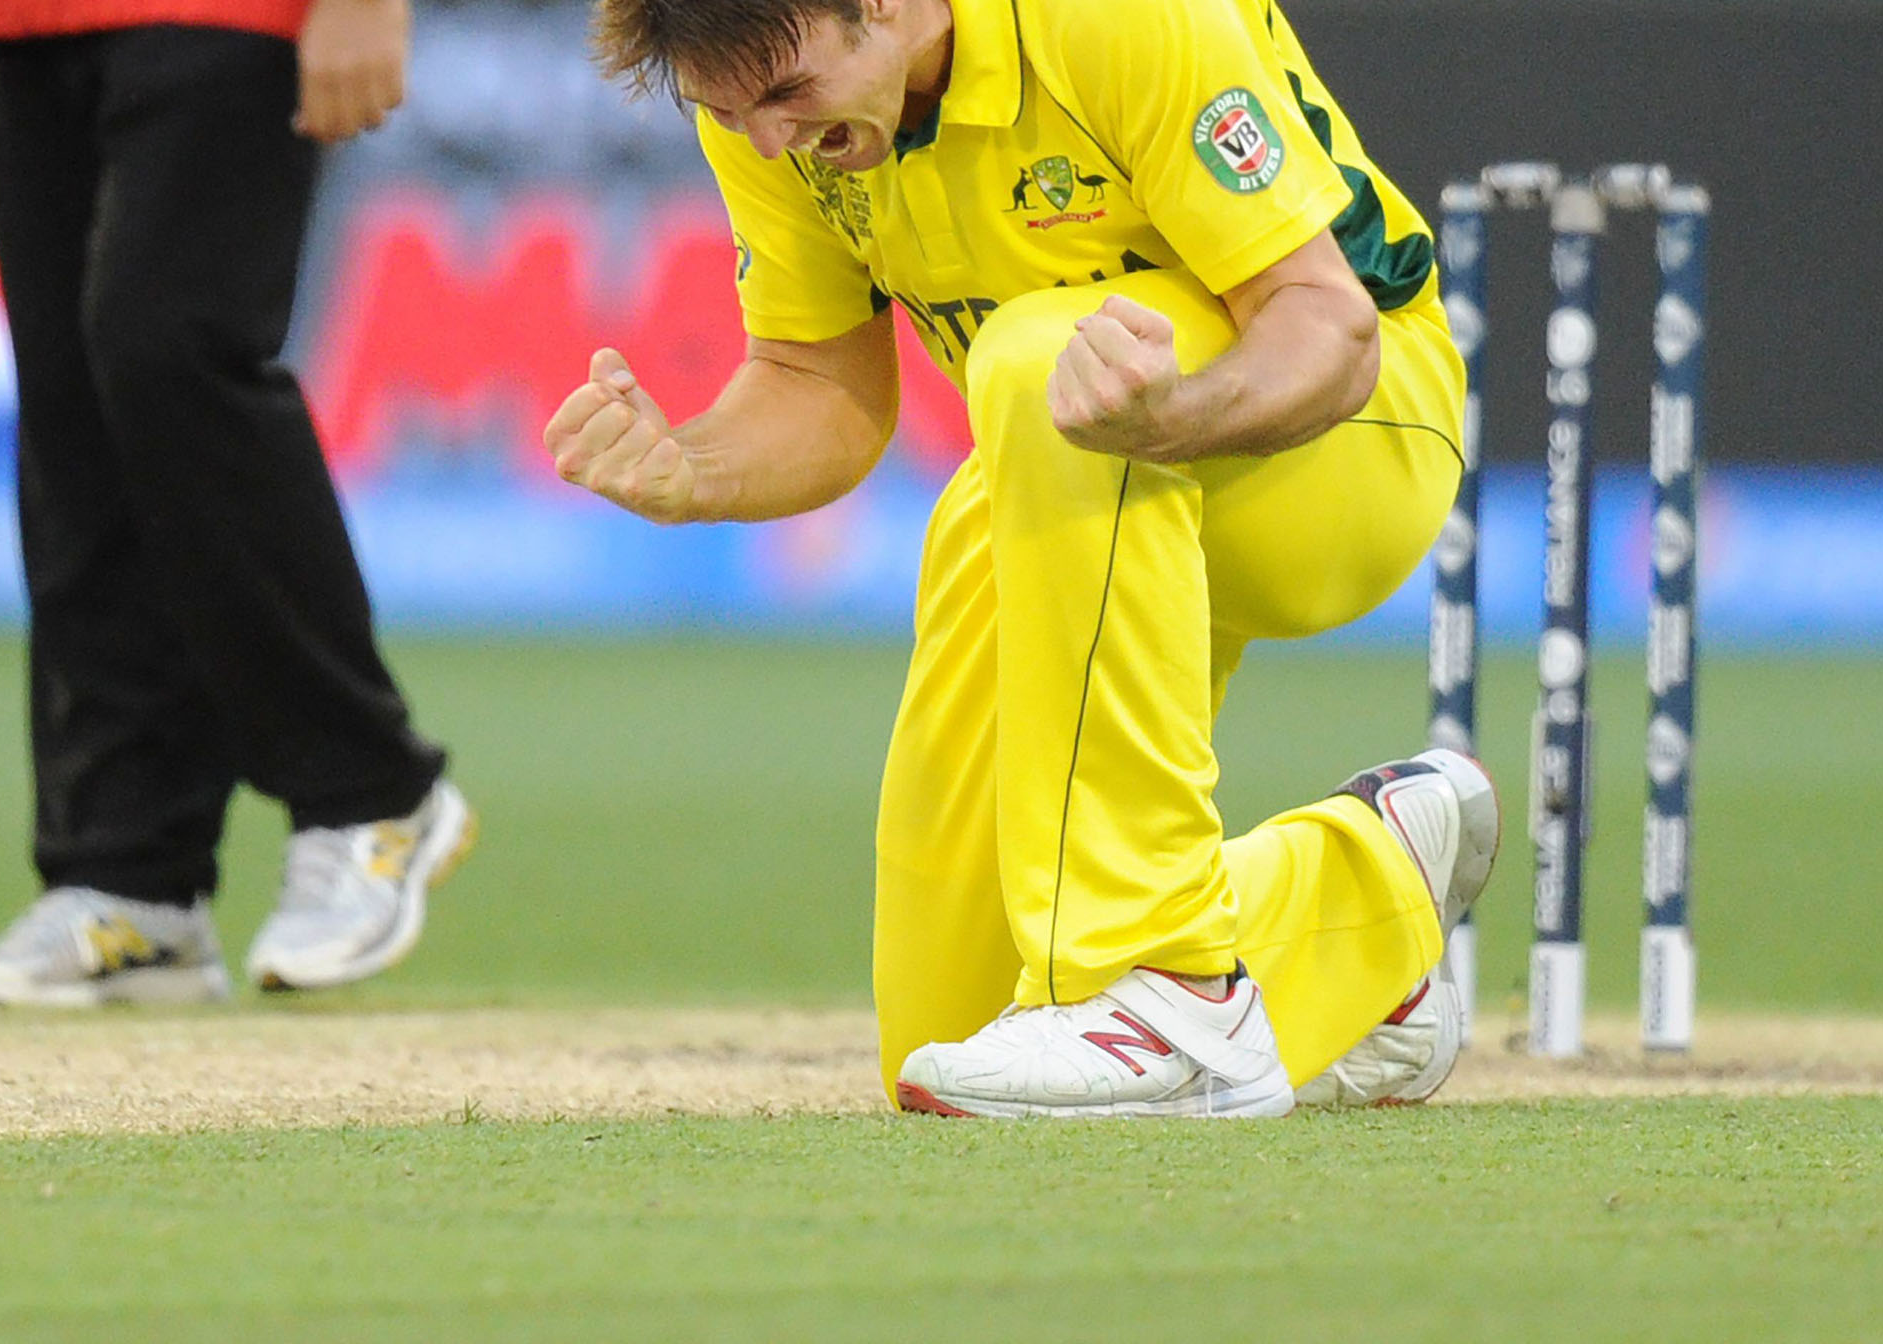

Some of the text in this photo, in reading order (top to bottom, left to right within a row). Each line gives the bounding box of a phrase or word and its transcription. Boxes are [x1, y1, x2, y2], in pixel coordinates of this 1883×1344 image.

[1195, 90, 1249, 144] VICTORIA
[1218, 121, 1259, 158] VB
[1544, 419, 1580, 607] RELIANCE
[1534, 745, 1569, 933] RELIACE
